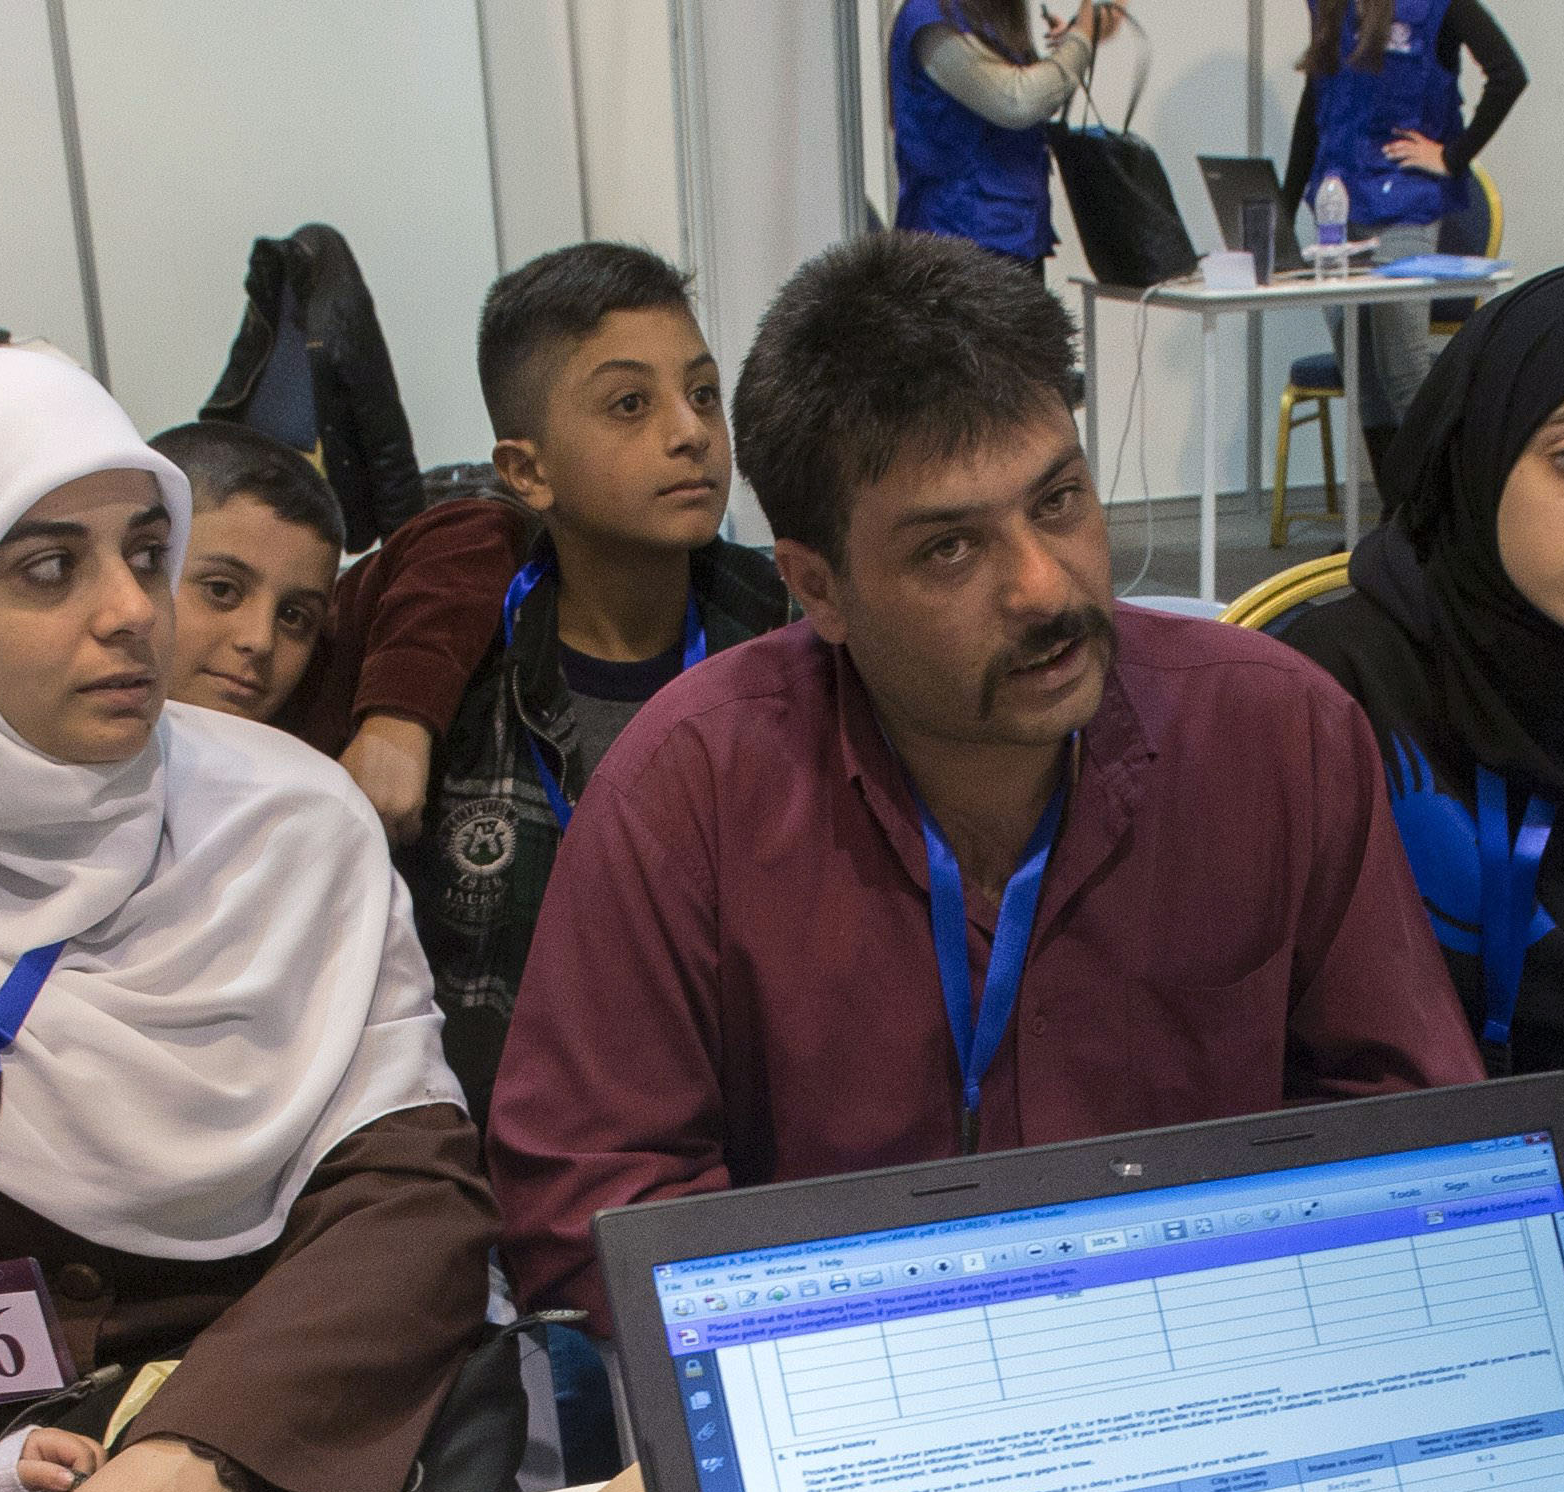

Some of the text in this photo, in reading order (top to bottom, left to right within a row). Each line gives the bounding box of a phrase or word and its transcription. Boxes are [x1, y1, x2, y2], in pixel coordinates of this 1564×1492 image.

[1491, 1168, 1549, 1184] Comment
[1389, 1188, 1422, 1200] Tools
[1443, 1180, 1471, 1193] Sign
[819, 1258, 844, 1269] Help
[664, 1263, 807, 1292] File Edit View Window
[708, 1321, 740, 1334] Please
[742, 1318, 755, 1328] fill
[758, 1315, 775, 1326] out
[777, 1312, 794, 1323] the
[795, 1304, 844, 1320] following
[876, 1296, 896, 1307] You
[898, 1290, 932, 1303] cannot
[934, 1286, 956, 1297] save
[958, 1282, 979, 1294] data
[981, 1278, 1008, 1290] typed
[1011, 1274, 1030, 1285] into
[1032, 1271, 1050, 1282] this
[707, 1332, 739, 1345] Please
[741, 1328, 766, 1340] print
[768, 1324, 791, 1335] your
[793, 1315, 848, 1331] completed
[850, 1310, 875, 1322] form
[877, 1309, 883, 1318] if
[886, 1306, 904, 1316] you
[905, 1300, 939, 1313] would
[940, 1297, 958, 1308] like
[967, 1292, 992, 1303] copy
[993, 1289, 1007, 1299] for
[1009, 1285, 1033, 1296] your
[795, 1445, 840, 1459] Personal
[842, 1438, 877, 1451] history
